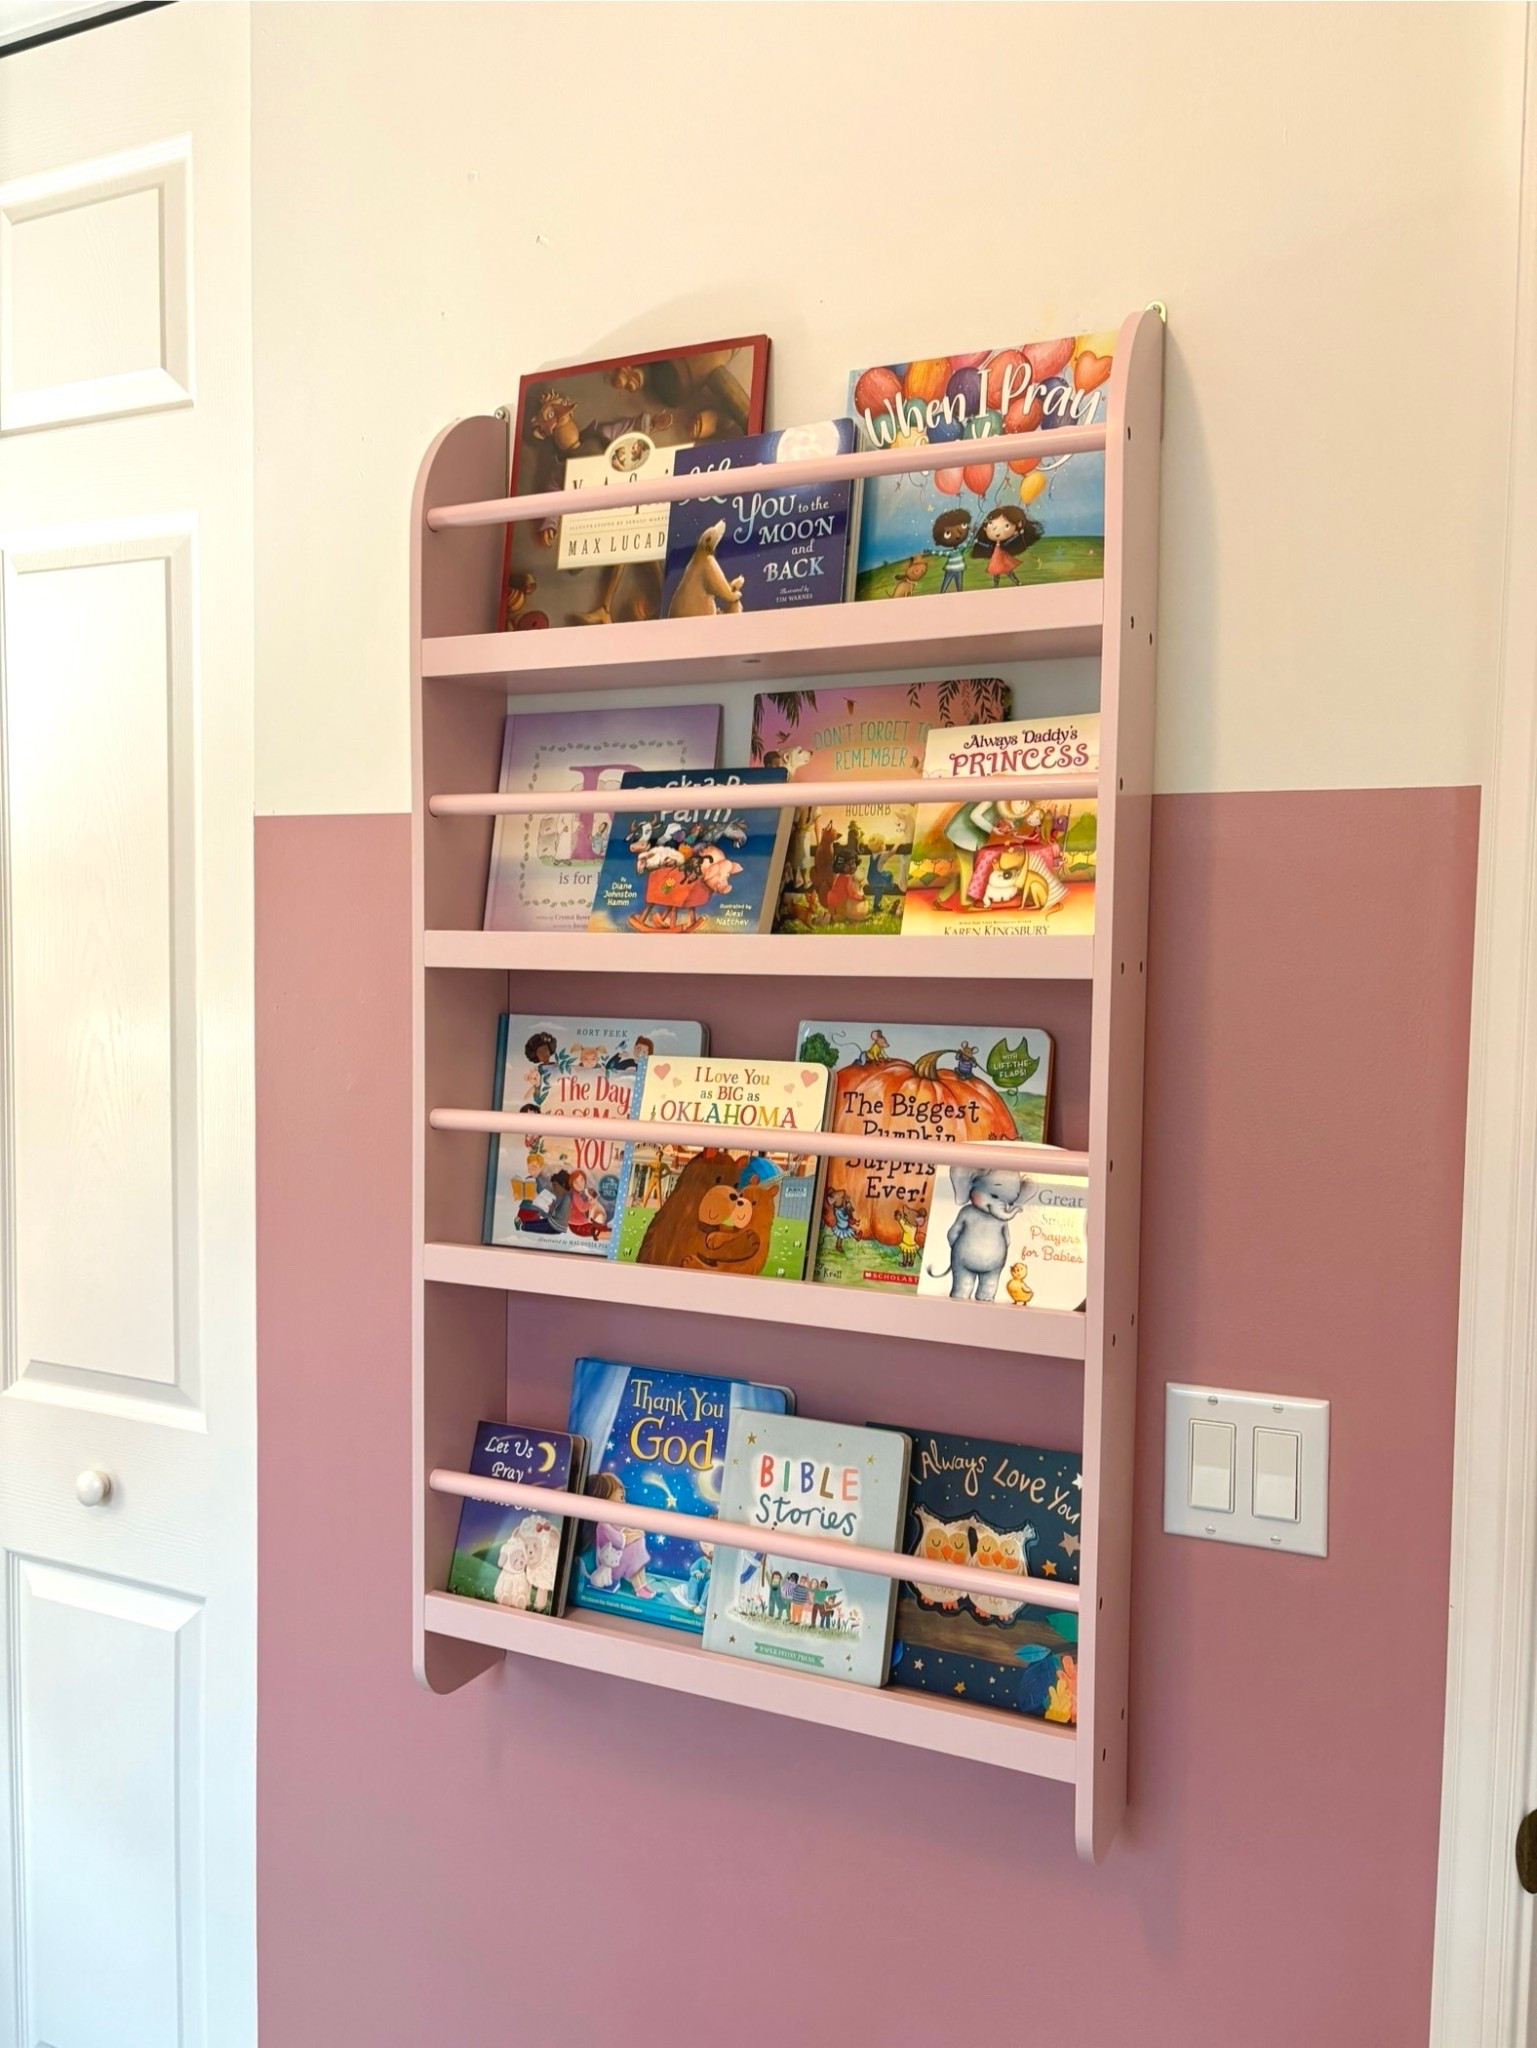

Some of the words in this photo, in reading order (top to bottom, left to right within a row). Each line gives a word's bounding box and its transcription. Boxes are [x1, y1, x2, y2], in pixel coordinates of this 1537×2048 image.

[864, 392, 966, 447] When
[975, 368, 991, 419] I
[1001, 362, 1101, 426] Pray
[798, 503, 809, 513] to
[811, 496, 830, 511] the
[758, 516, 835, 546] MOON
[568, 538, 601, 557] MAX
[610, 531, 665, 552] LUCAD
[791, 538, 815, 555] and
[763, 556, 825, 582] BACK
[813, 723, 853, 751] DON'T
[860, 720, 910, 742] FORGET
[963, 734, 1018, 750] Always
[1022, 725, 1078, 745] Daddy's
[835, 746, 909, 771] REMEMBER
[949, 743, 1090, 777] PRINCESS
[559, 872, 569, 885] is
[573, 871, 593, 885] for
[611, 881, 632, 890] Diane
[603, 889, 637, 899] Johnston
[576, 1028, 601, 1036] RORY
[603, 1029, 628, 1038] FEEK
[695, 1066, 702, 1082] I
[704, 1067, 739, 1084] Love
[744, 1068, 770, 1086] You
[999, 1068, 1027, 1078] FLAPS!
[557, 1075, 590, 1103] The
[595, 1076, 631, 1116] Day
[700, 1089, 713, 1099] as
[717, 1086, 744, 1101] BIG
[747, 1091, 760, 1102] as
[660, 1099, 798, 1129] OKLAHOMA
[843, 1091, 884, 1117] The
[891, 1092, 980, 1124] Biggest
[574, 1138, 614, 1172] YOU
[845, 1157, 936, 1179] urpris
[865, 1176, 928, 1203] Ever!
[1038, 1189, 1084, 1208] Great
[1030, 1225, 1081, 1247] Prayers
[1021, 1245, 1039, 1261] for
[1042, 1245, 1084, 1264] Babies
[872, 1271, 918, 1284] SCHOLAST
[631, 1378, 688, 1422] Thank
[689, 1387, 725, 1422] You
[484, 1436, 510, 1454] Let
[514, 1438, 534, 1459] Us
[629, 1415, 714, 1471] God
[491, 1461, 524, 1484] Pray
[760, 1454, 859, 1501] BIBLE
[921, 1439, 988, 1497] Always
[992, 1458, 1047, 1504] Love
[756, 1493, 857, 1537] Stories
